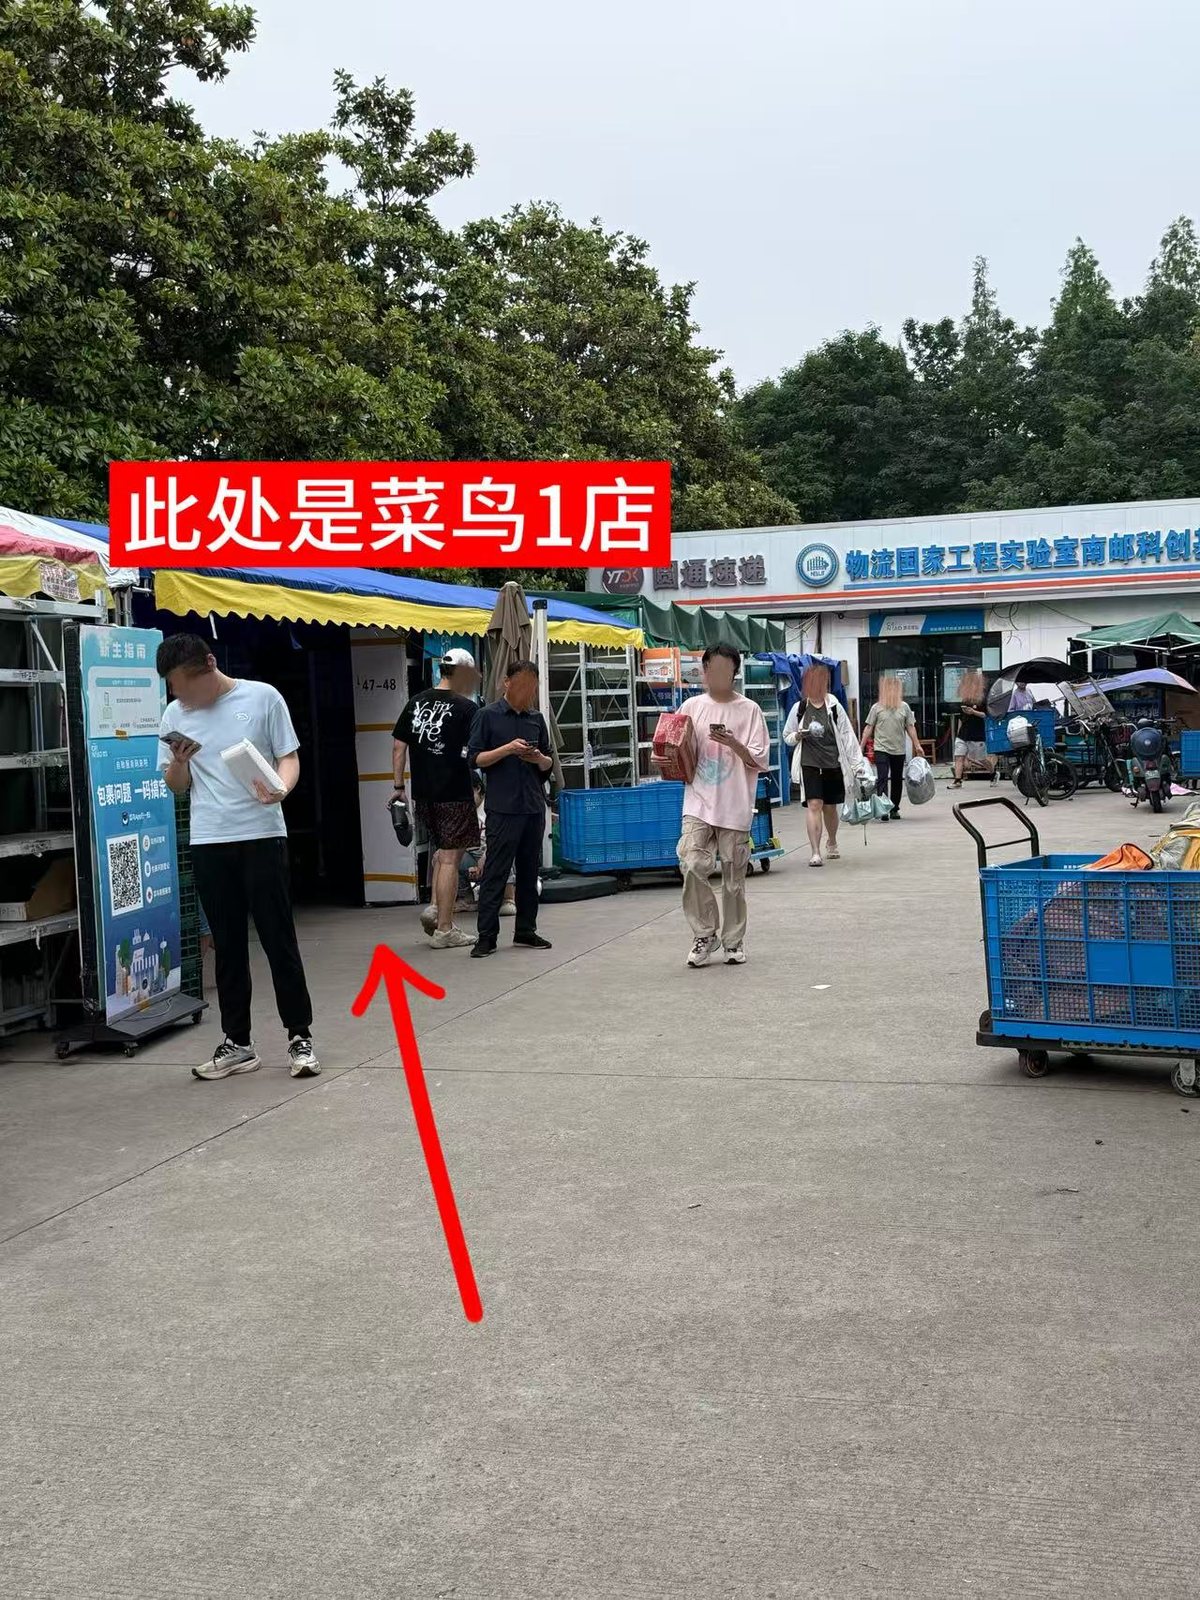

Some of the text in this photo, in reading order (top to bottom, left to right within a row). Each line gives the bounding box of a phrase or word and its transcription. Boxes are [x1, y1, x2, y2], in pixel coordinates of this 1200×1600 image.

[845, 528, 1200, 581] 物流国家工程实验室南邮科创
[653, 554, 768, 592] 圆通速递
[100, 641, 146, 659] 新生指南
[362, 678, 397, 691] 47-48
[97, 777, 168, 807] 包裹问题 一码搞定
